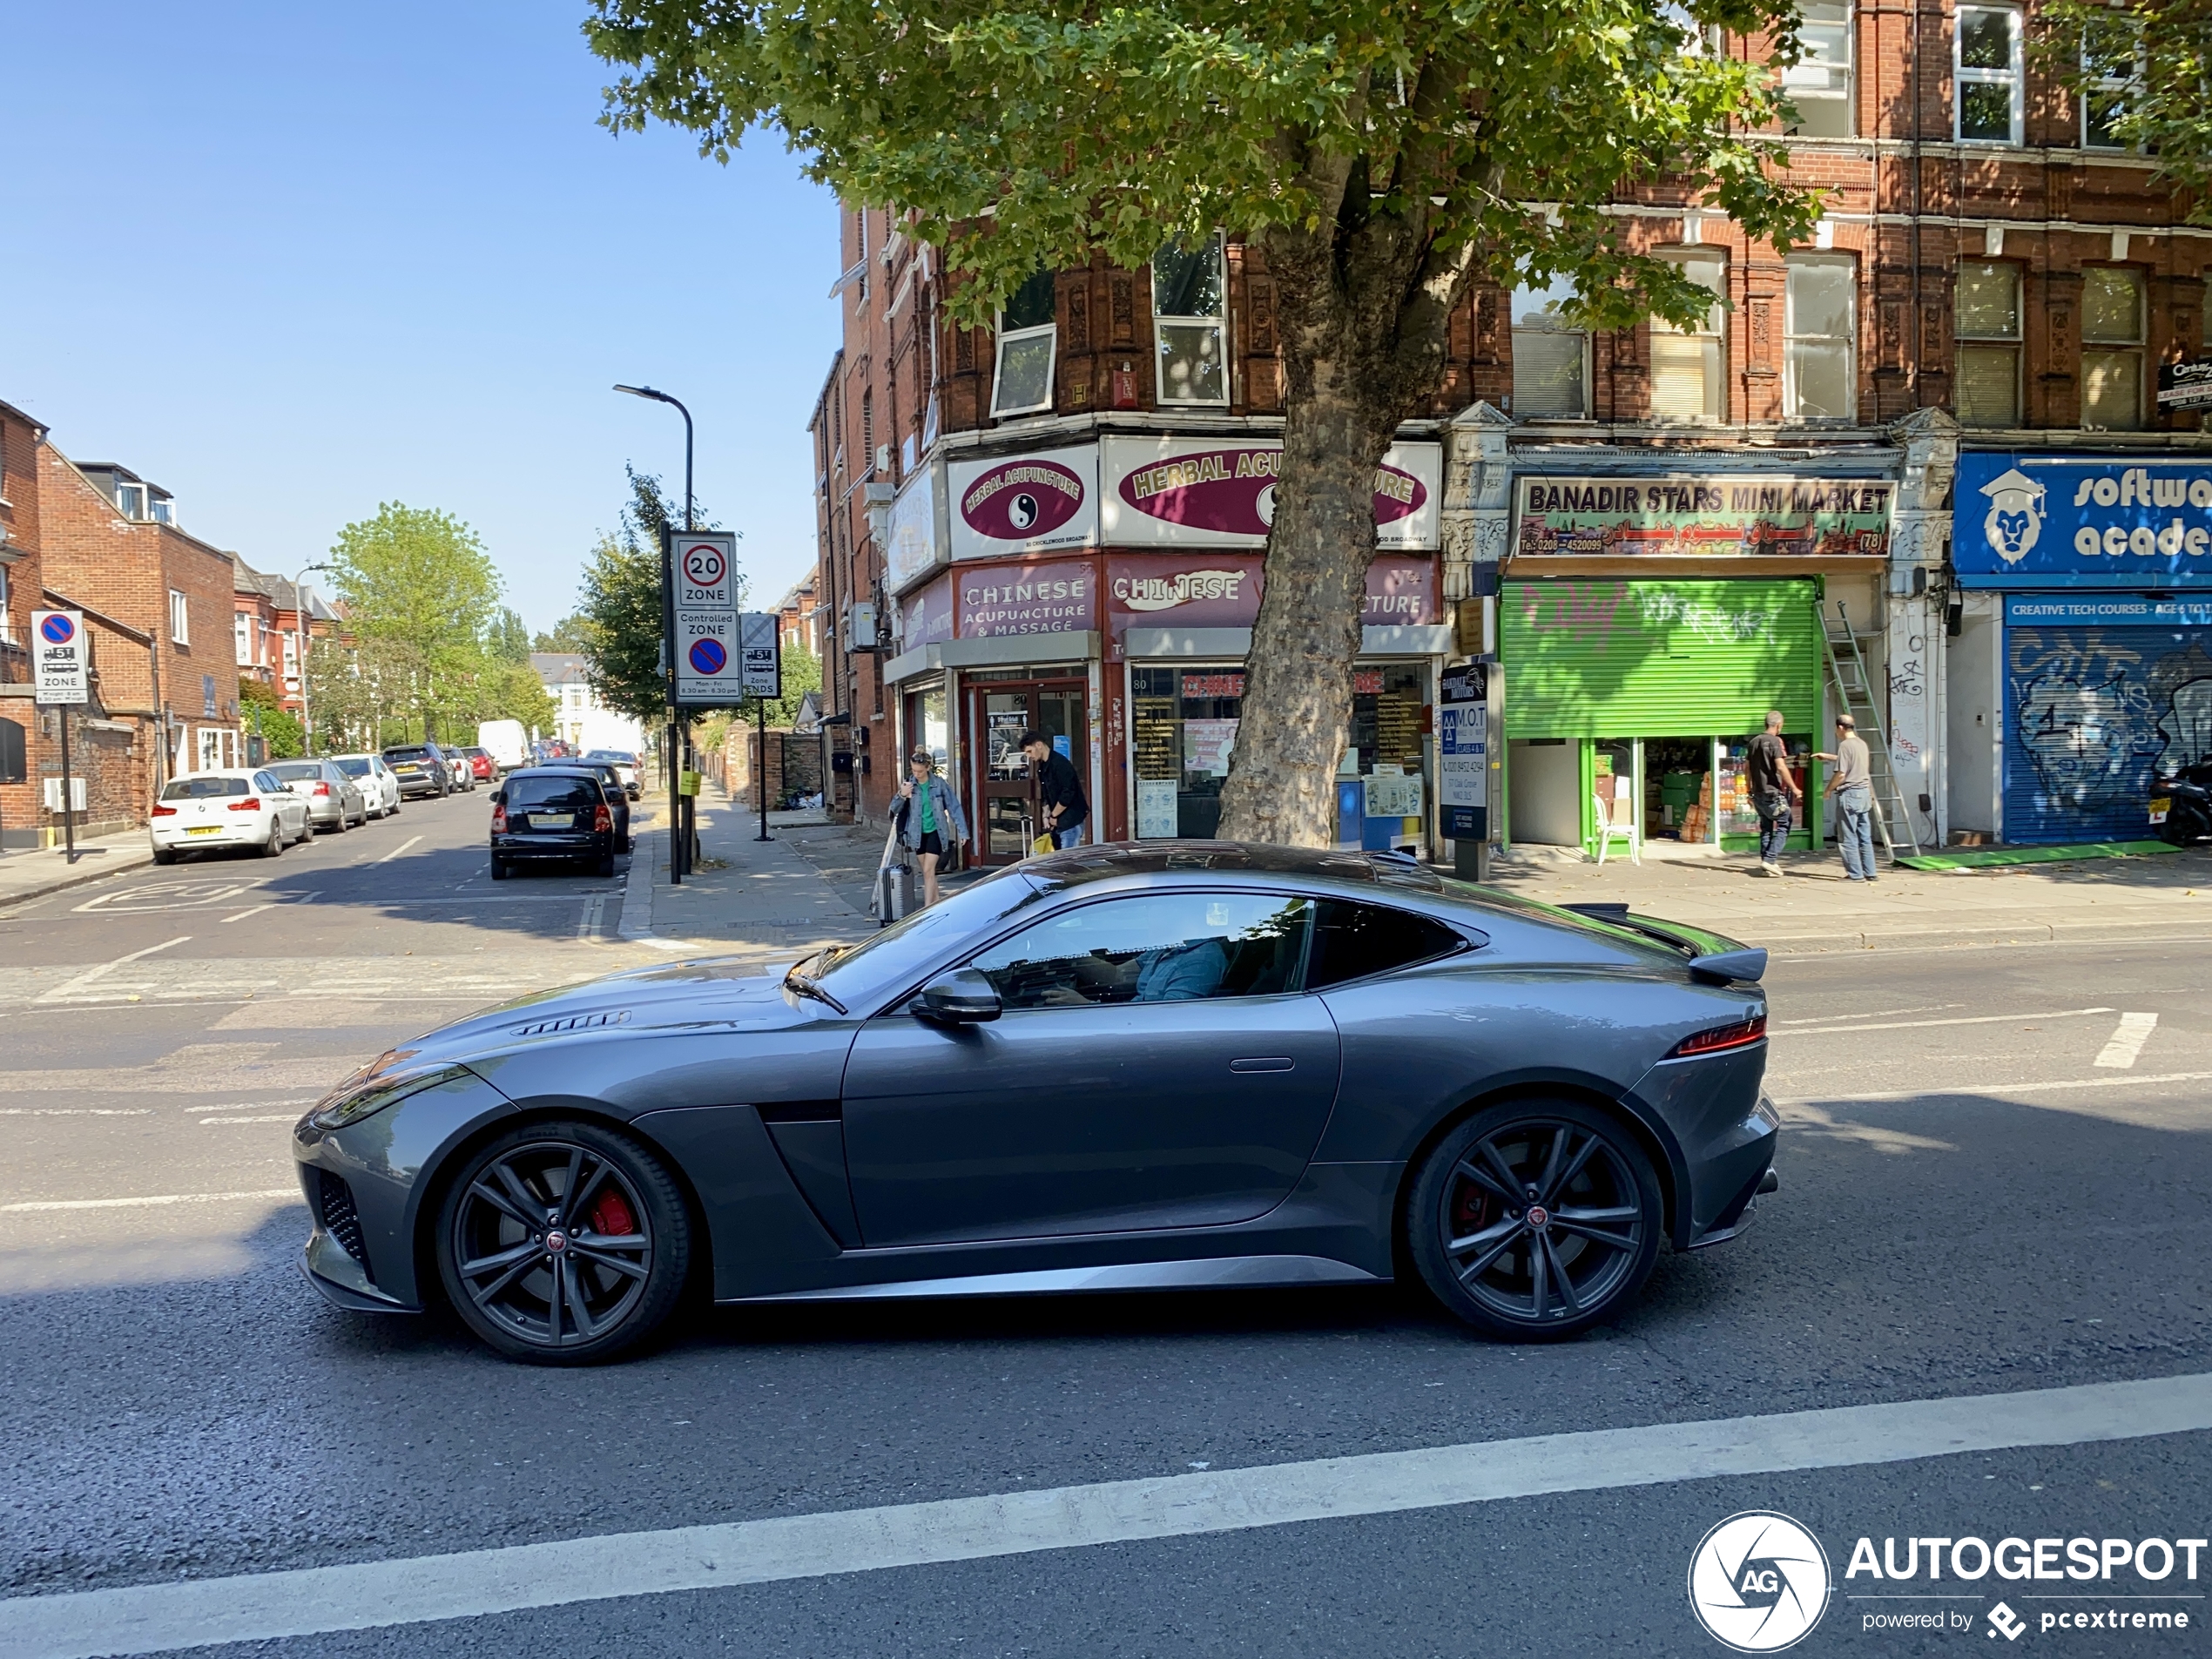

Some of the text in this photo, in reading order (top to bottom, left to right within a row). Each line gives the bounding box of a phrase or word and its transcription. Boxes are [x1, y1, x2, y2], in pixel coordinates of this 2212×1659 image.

[1133, 453, 1285, 500] HERBAL ACU
[965, 467, 1080, 515] HERBAL ACUPUNCTURE
[1374, 469, 1415, 504] URE
[2074, 469, 2212, 507] softwa
[1529, 486, 1889, 513] BANADIR STARS MINI MARKET
[1538, 540, 1557, 550] 0208
[1567, 540, 1602, 551] 4520099
[1860, 534, 1883, 550] (78)
[2074, 518, 2212, 556] acade
[691, 557, 719, 574] 20
[686, 590, 725, 600] ZONE
[966, 578, 1086, 605] CHINESE
[1112, 577, 1240, 601] CHINESE
[1360, 595, 1421, 613] TURE
[2012, 604, 2065, 616] CREATIVE
[2067, 604, 2096, 615] TECH
[2098, 604, 2147, 615] COURSES
[2155, 604, 2177, 614] AGE
[2179, 604, 2185, 614] 6
[2187, 604, 2202, 614] TO
[681, 614, 732, 623] Controlled
[965, 605, 1086, 624] ACUPUNCTURE
[689, 625, 725, 635] ZONE
[978, 621, 1072, 637] & MASSAGE
[1134, 680, 1146, 689] 80
[1183, 675, 1244, 697] CHINE
[1354, 672, 1385, 694] NE
[1014, 695, 1027, 705] 80
[1451, 686, 1474, 699] MOTORS
[1457, 707, 1485, 727] M.O.T
[1458, 745, 1471, 753] CLASS
